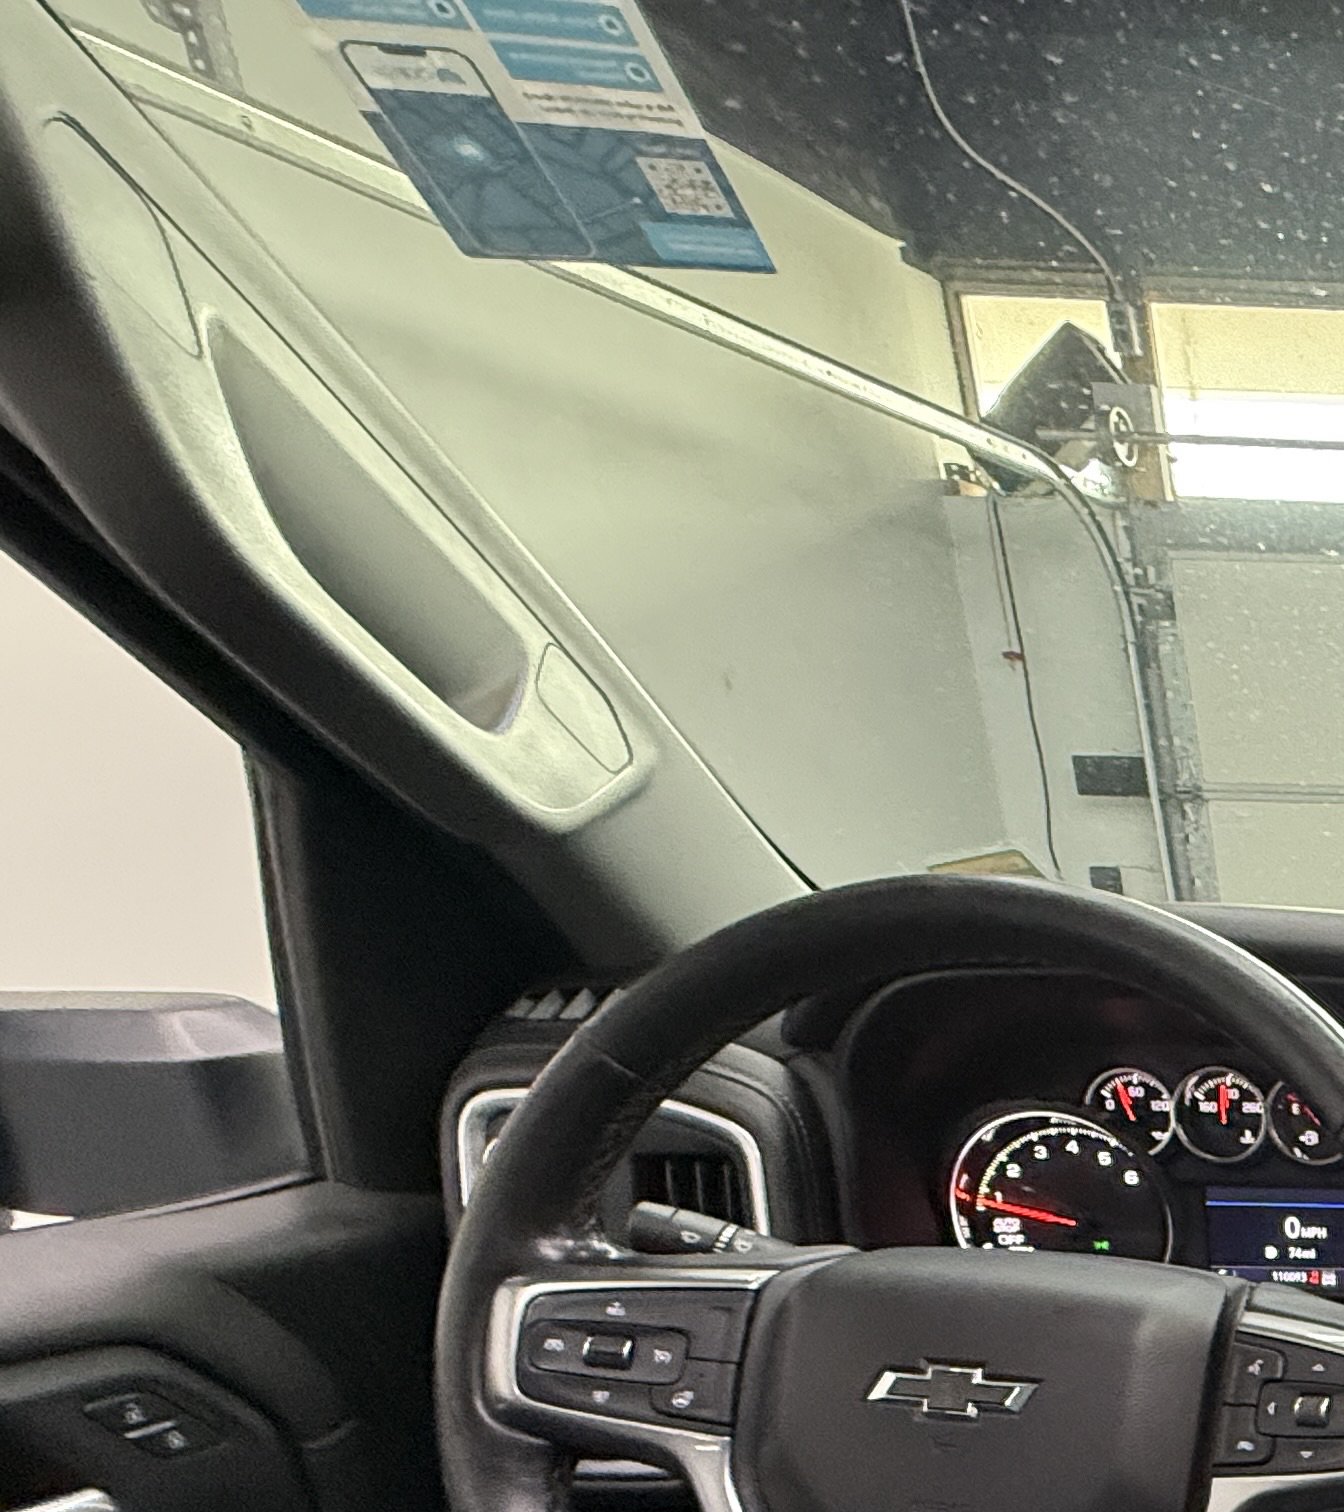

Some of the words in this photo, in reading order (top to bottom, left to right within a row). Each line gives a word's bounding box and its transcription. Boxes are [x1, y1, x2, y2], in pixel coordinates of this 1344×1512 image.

[1150, 1100, 1170, 1112] 120
[1033, 1146, 1048, 1160] 3
[1065, 1140, 1080, 1154] 4
[1097, 1151, 1112, 1166] 5
[1006, 1163, 1021, 1178] 2
[1123, 1170, 1139, 1185] 6
[1284, 1215, 1301, 1239] 0
[1301, 1226, 1328, 1239] MPH
[998, 1234, 1025, 1246] OFF
